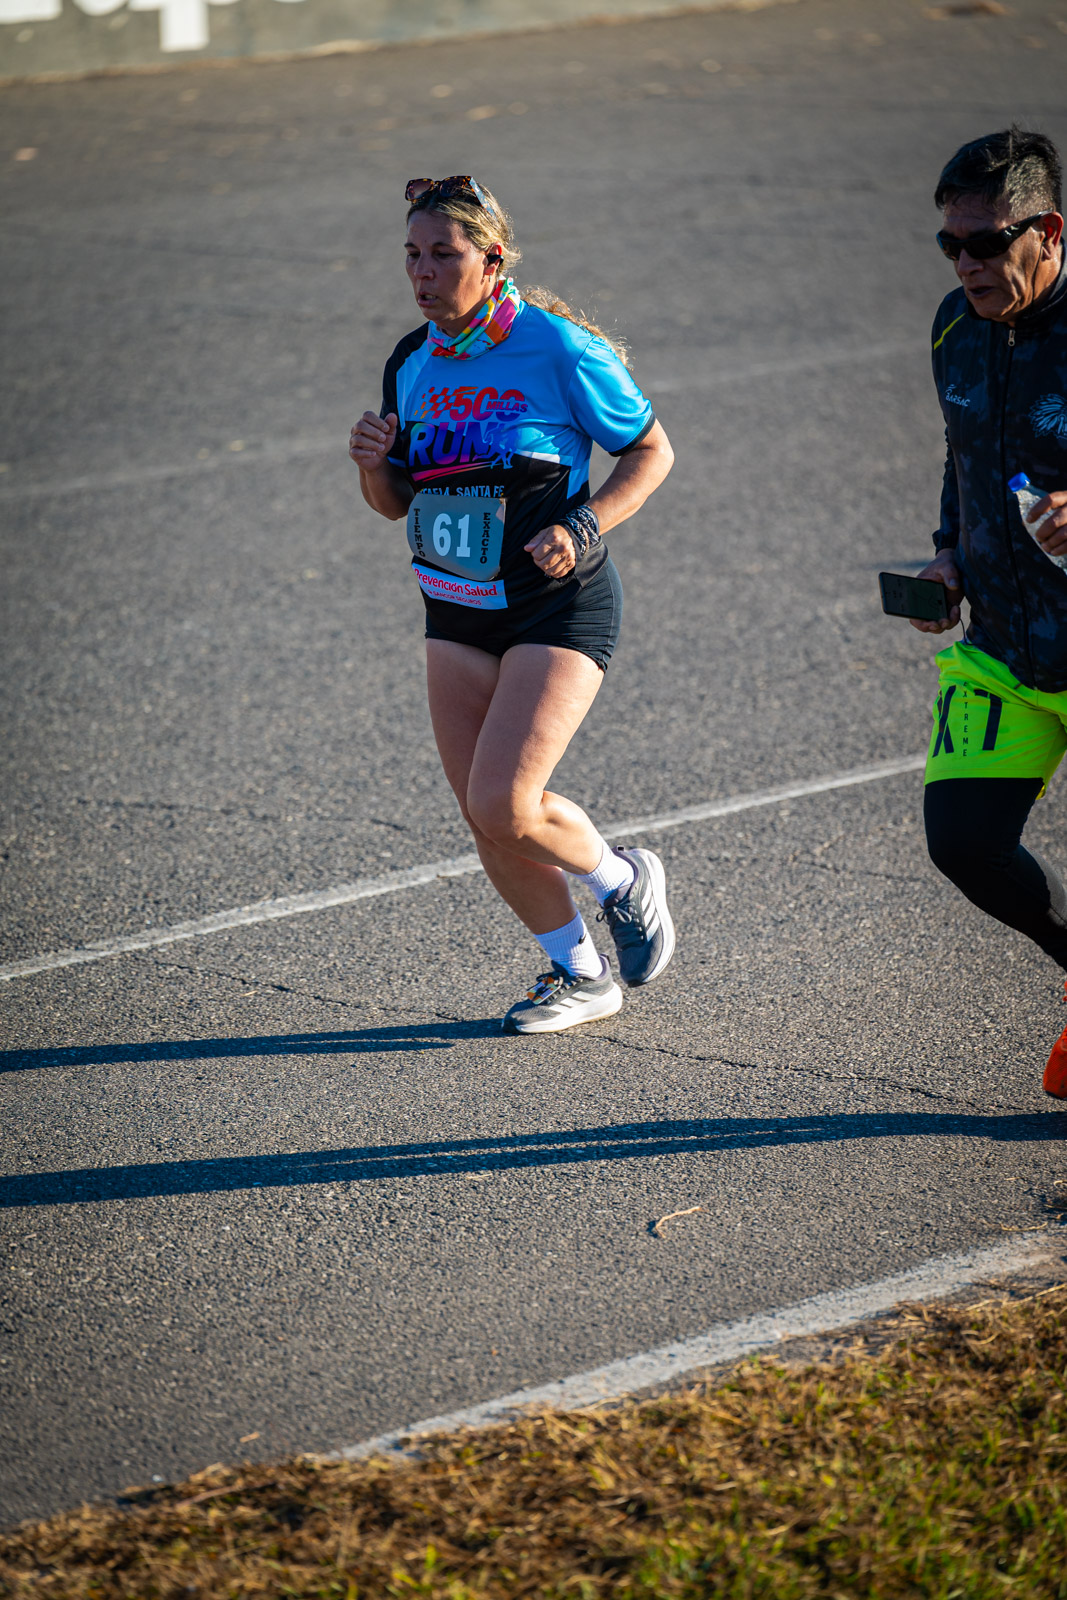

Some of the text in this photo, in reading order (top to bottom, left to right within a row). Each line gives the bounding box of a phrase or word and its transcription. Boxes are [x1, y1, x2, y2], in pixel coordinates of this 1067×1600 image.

[486, 399, 528, 413] MILLAS
[408, 421, 509, 467] RUN
[456, 485, 492, 498] SANTA
[493, 485, 505, 498] FE
[413, 508, 426, 558] TIEMPO
[432, 513, 471, 558] 61
[480, 512, 491, 565] EXACTO
[464, 584, 498, 597] Salud
[962, 681, 970, 757] EXTREME
